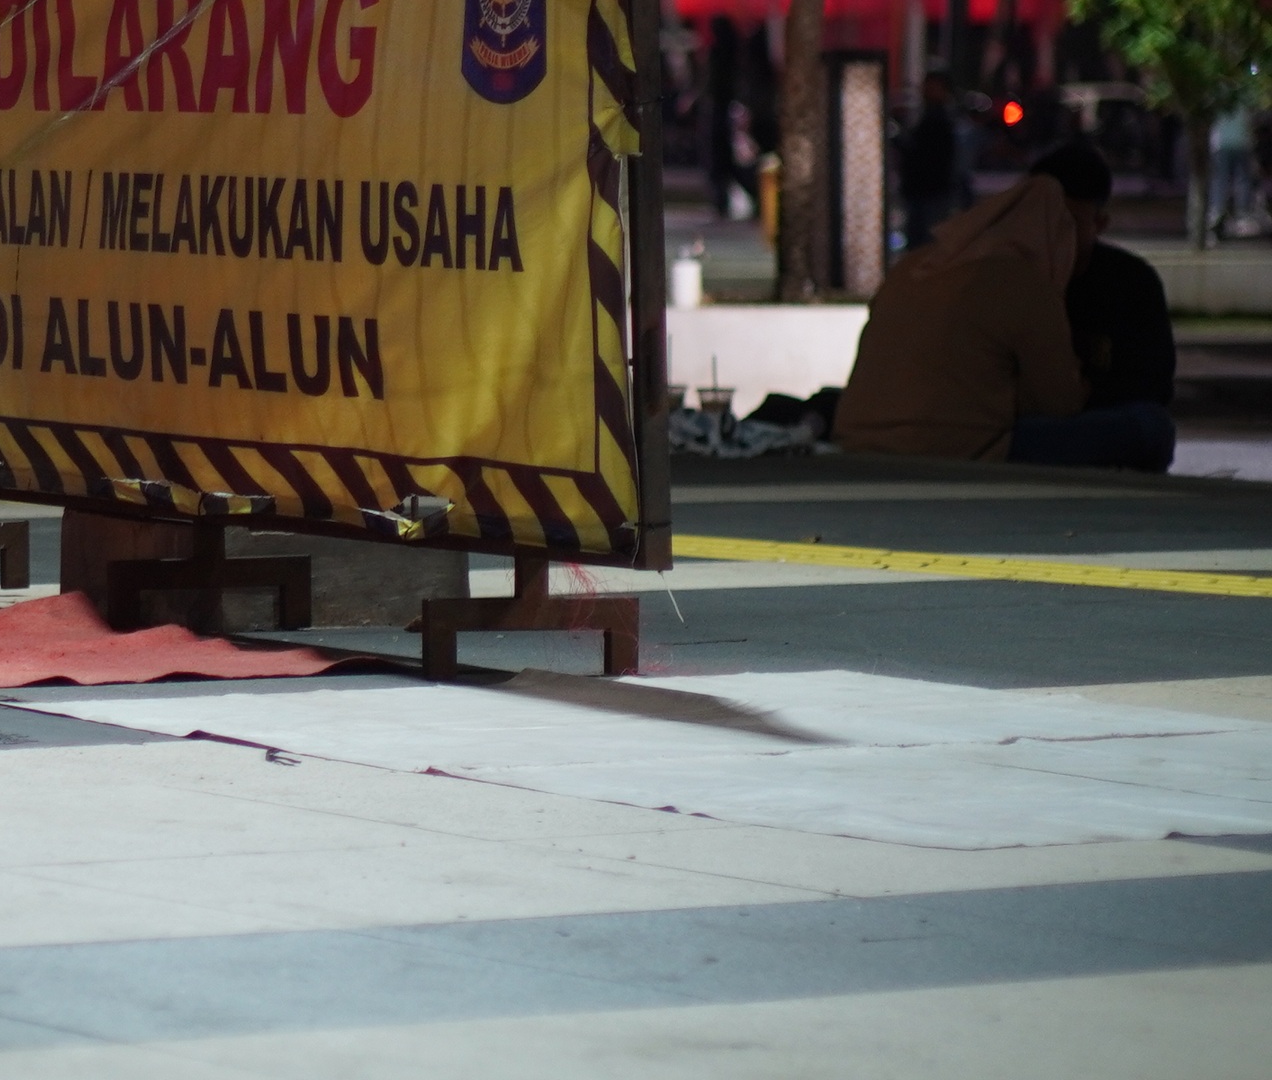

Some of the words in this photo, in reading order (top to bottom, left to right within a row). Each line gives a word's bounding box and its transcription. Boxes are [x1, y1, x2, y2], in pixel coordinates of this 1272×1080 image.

[78, 170, 93, 250] /
[99, 172, 343, 263] MELAKUKAN
[360, 180, 525, 272] USAHA
[39, 296, 385, 400] ALUN-ALUN
